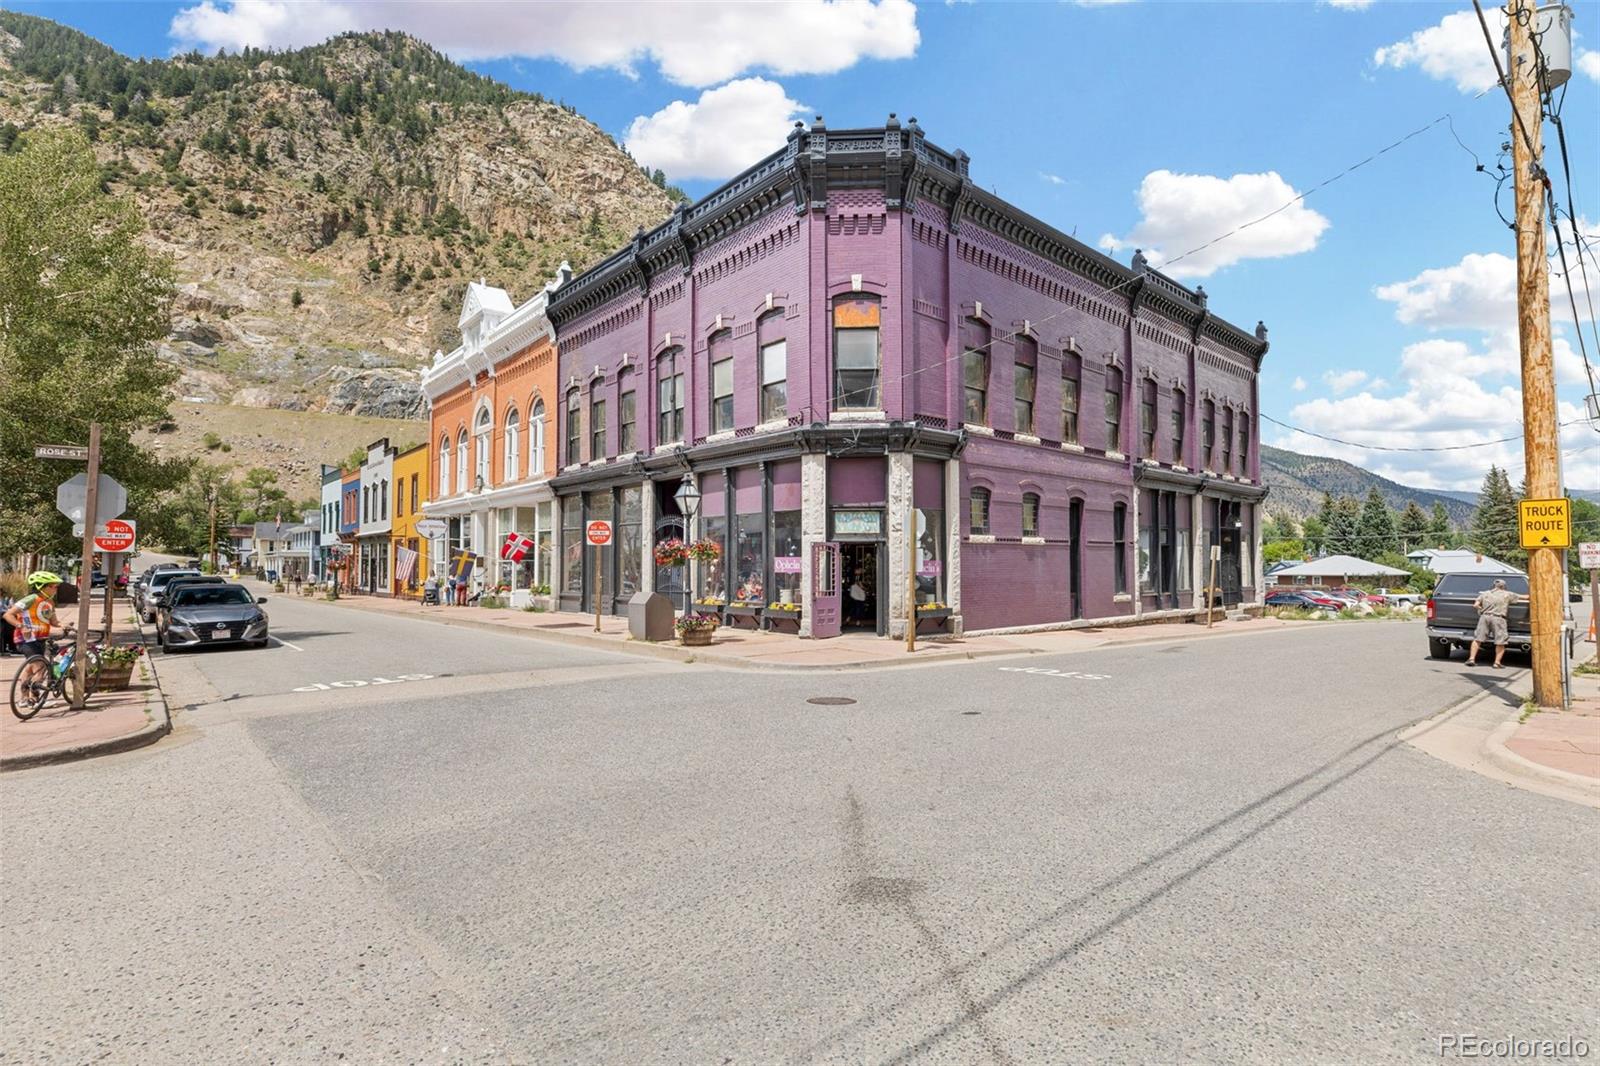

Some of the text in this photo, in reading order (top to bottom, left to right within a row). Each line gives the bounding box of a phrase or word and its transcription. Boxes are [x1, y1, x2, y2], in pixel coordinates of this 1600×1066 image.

[829, 140, 883, 151] FISH BLOCK
[40, 447, 82, 457] ROSE ST
[1525, 506, 1563, 516] TRUCK
[1526, 520, 1563, 531] ROUTE
